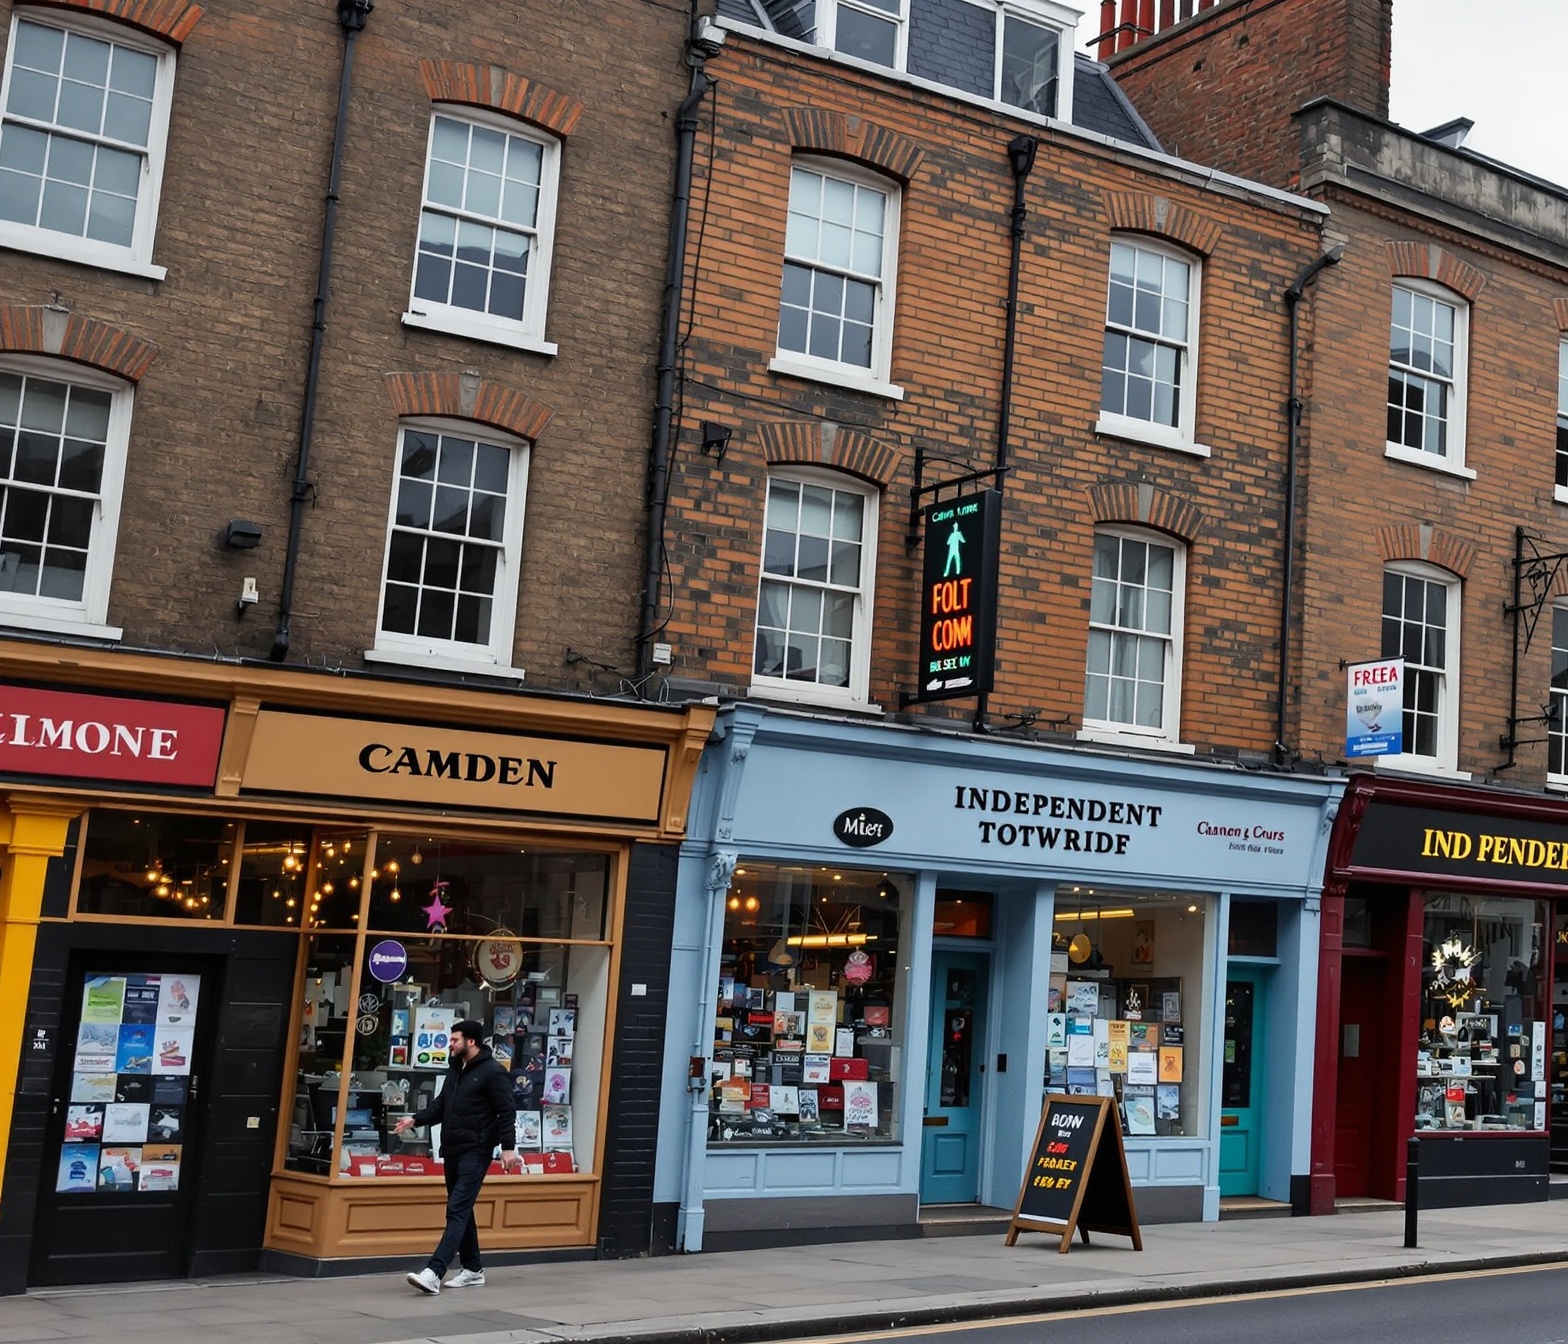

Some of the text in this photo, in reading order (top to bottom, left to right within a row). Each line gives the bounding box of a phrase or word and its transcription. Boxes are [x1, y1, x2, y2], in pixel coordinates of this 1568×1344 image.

[358, 743, 558, 789] CAMDEN
[954, 785, 1163, 827] INDEPENDENT
[1421, 829, 1472, 860] IND
